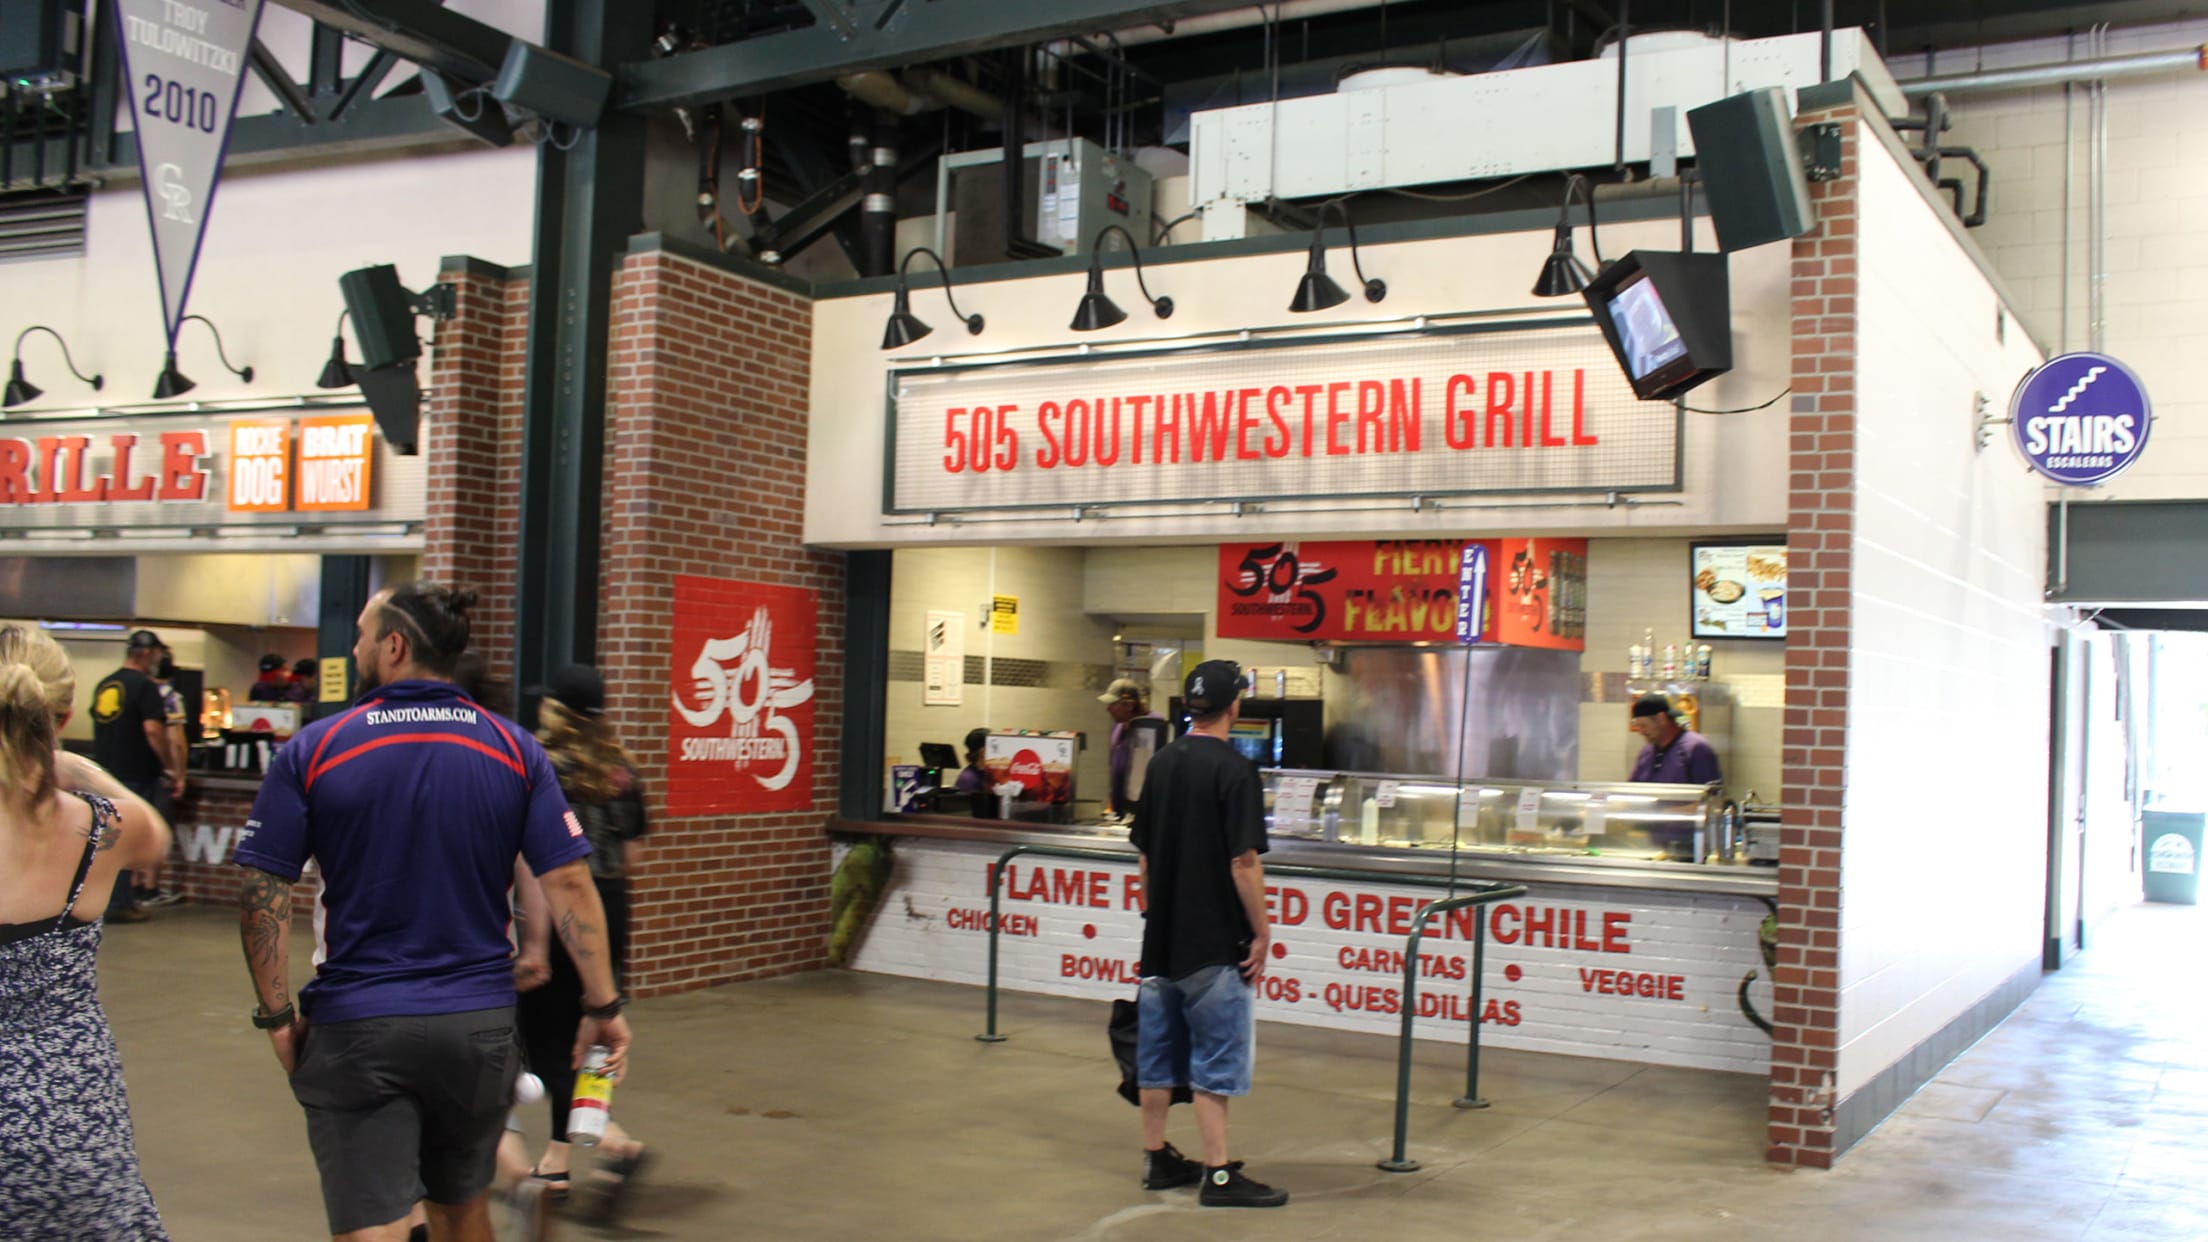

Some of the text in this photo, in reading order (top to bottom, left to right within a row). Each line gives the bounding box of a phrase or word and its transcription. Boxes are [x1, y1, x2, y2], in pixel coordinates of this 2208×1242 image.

[163, 0, 209, 35] TROY
[127, 15, 238, 76] TULOWITZKI
[144, 73, 217, 134] 2010
[303, 424, 368, 457] BRAT
[944, 369, 1600, 473] 505 SOUTHWESTERN GRILL
[2026, 414, 2136, 455] STAIRS
[234, 456, 284, 505] DOG
[302, 458, 366, 504] WURST
[1225, 543, 1338, 633] 505
[1344, 588, 1492, 633] FLAVO!
[1457, 548, 1474, 636] ENTER
[366, 707, 477, 725] STANDTOARMS.COM
[671, 629, 815, 791] 505
[986, 863, 1111, 909] FLAME
[1490, 903, 1632, 953] CHILE
[1579, 967, 1685, 1001] VEGGIE
